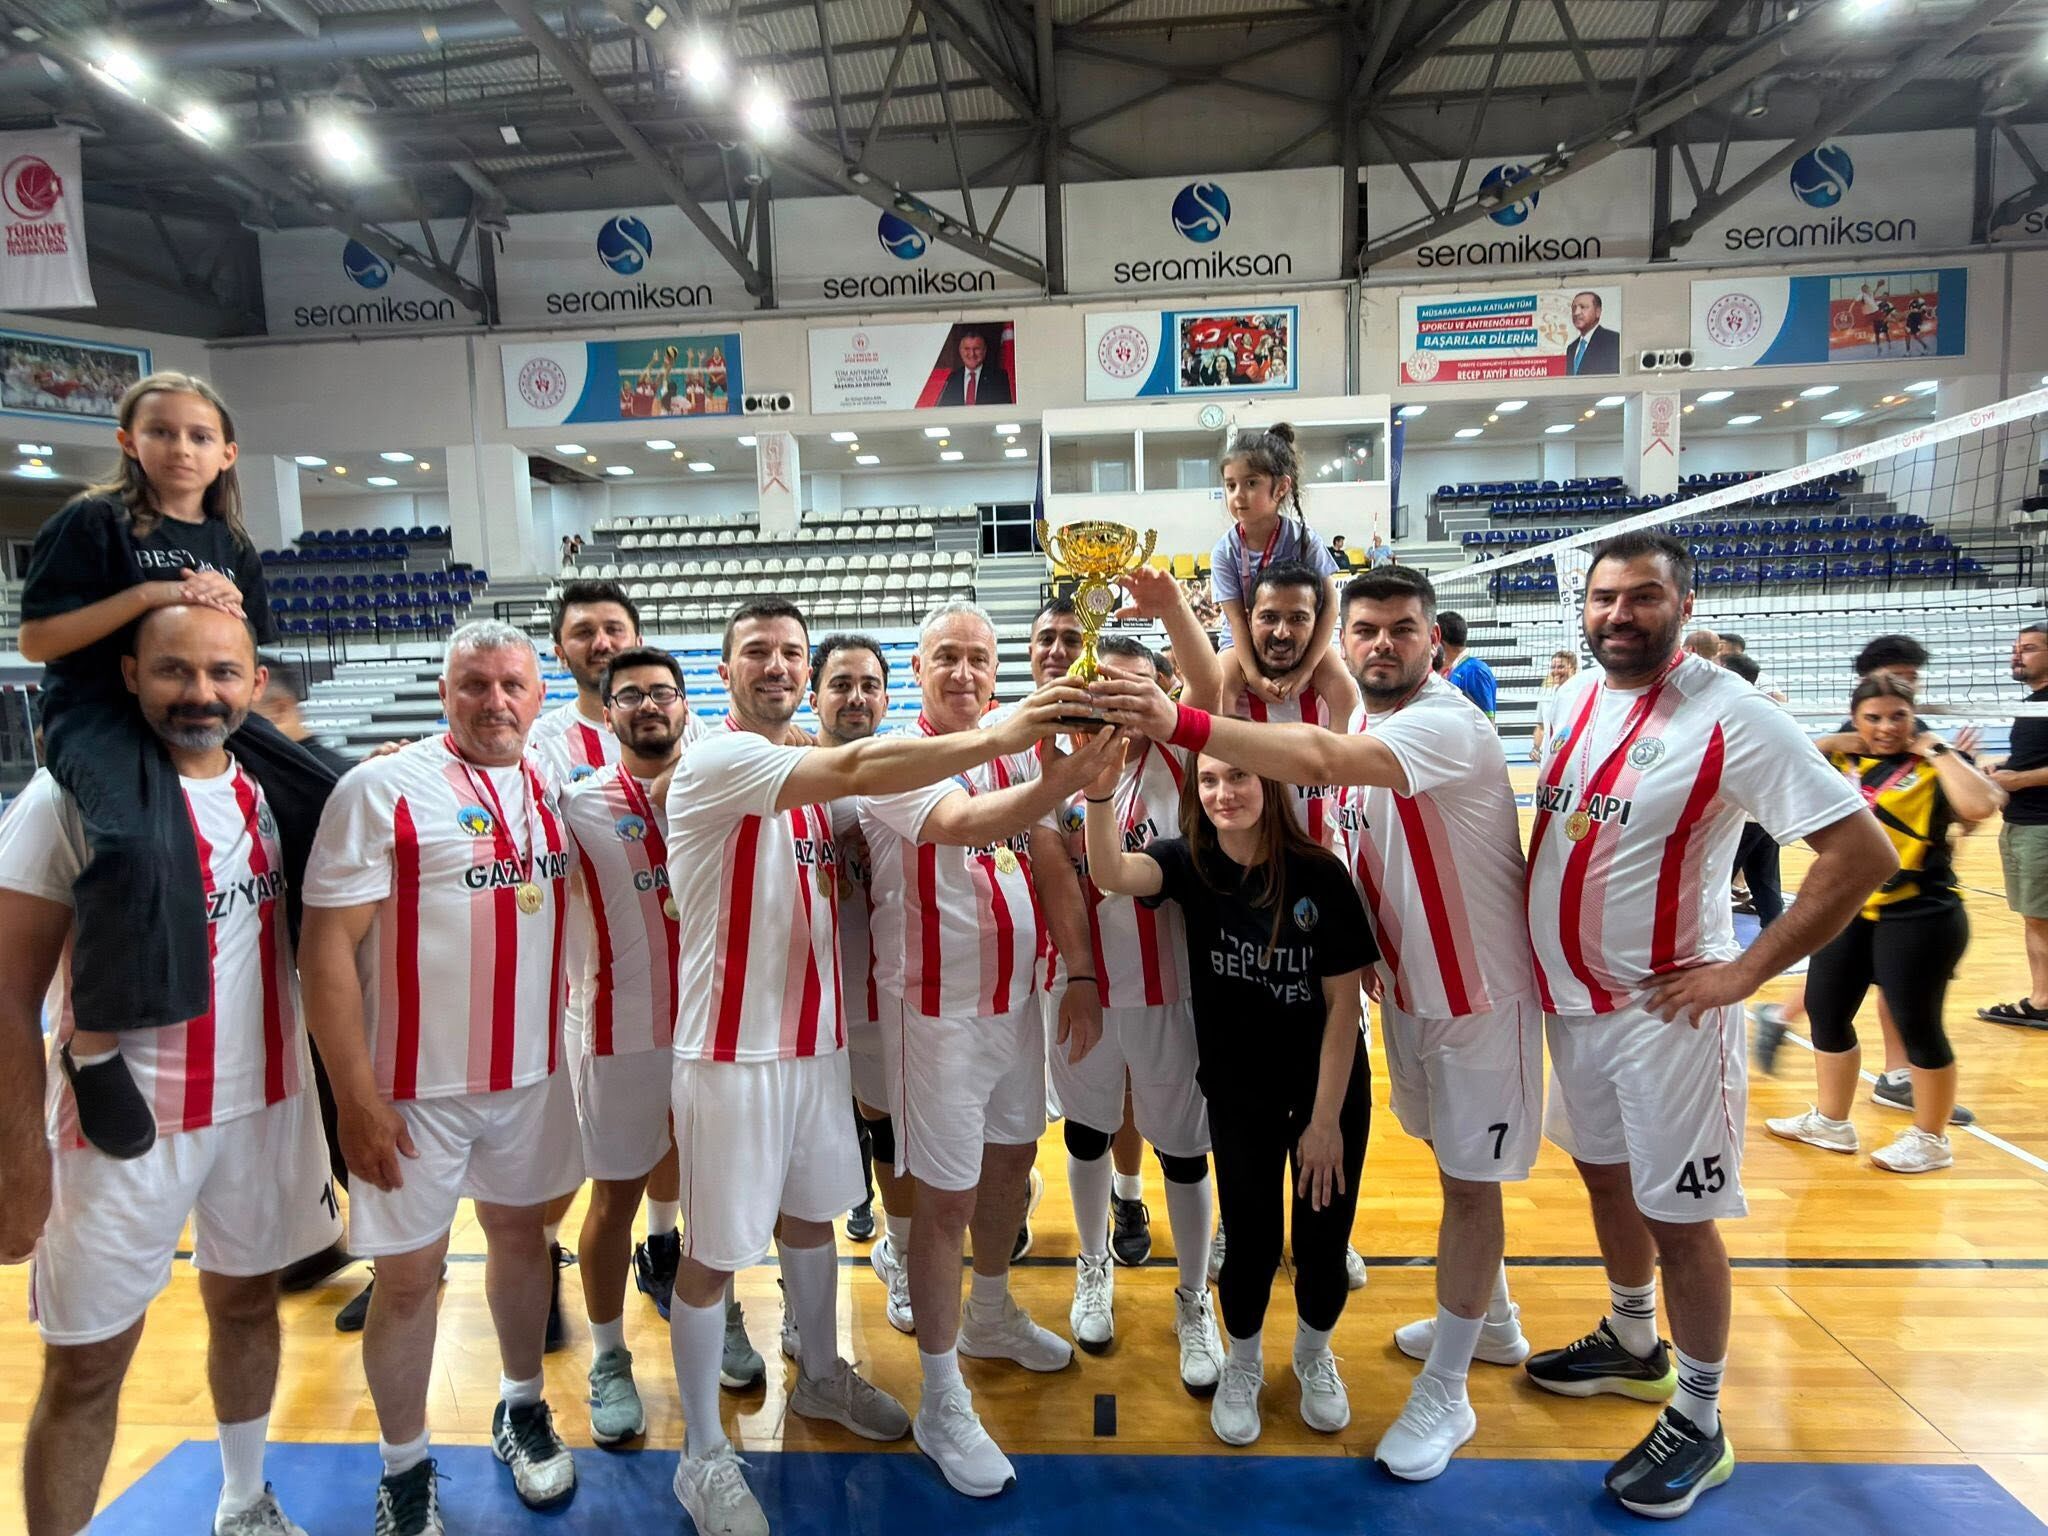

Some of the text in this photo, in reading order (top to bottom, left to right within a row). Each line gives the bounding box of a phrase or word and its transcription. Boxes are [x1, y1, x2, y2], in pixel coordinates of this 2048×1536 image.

[1725, 216, 1916, 250] seramiksan
[1417, 235, 1601, 267] seramiksan
[1114, 251, 1291, 283] seramiksan
[546, 282, 713, 314] seramiksan
[824, 268, 995, 299] seramiksan
[294, 296, 455, 327] seramiksan
[1422, 300, 1532, 317] MÜSABAKALARA KATILAN TÜM
[1421, 317, 1530, 332] SPORCU VE ANTRENÖRLERE
[1424, 331, 1537, 347] BAŞARILAR DİLERİM.
[1457, 366, 1548, 380] RECEP TAYYİP ERDOĞAN
[1488, 1123, 1508, 1160] 7
[1675, 1154, 1725, 1199] 45
